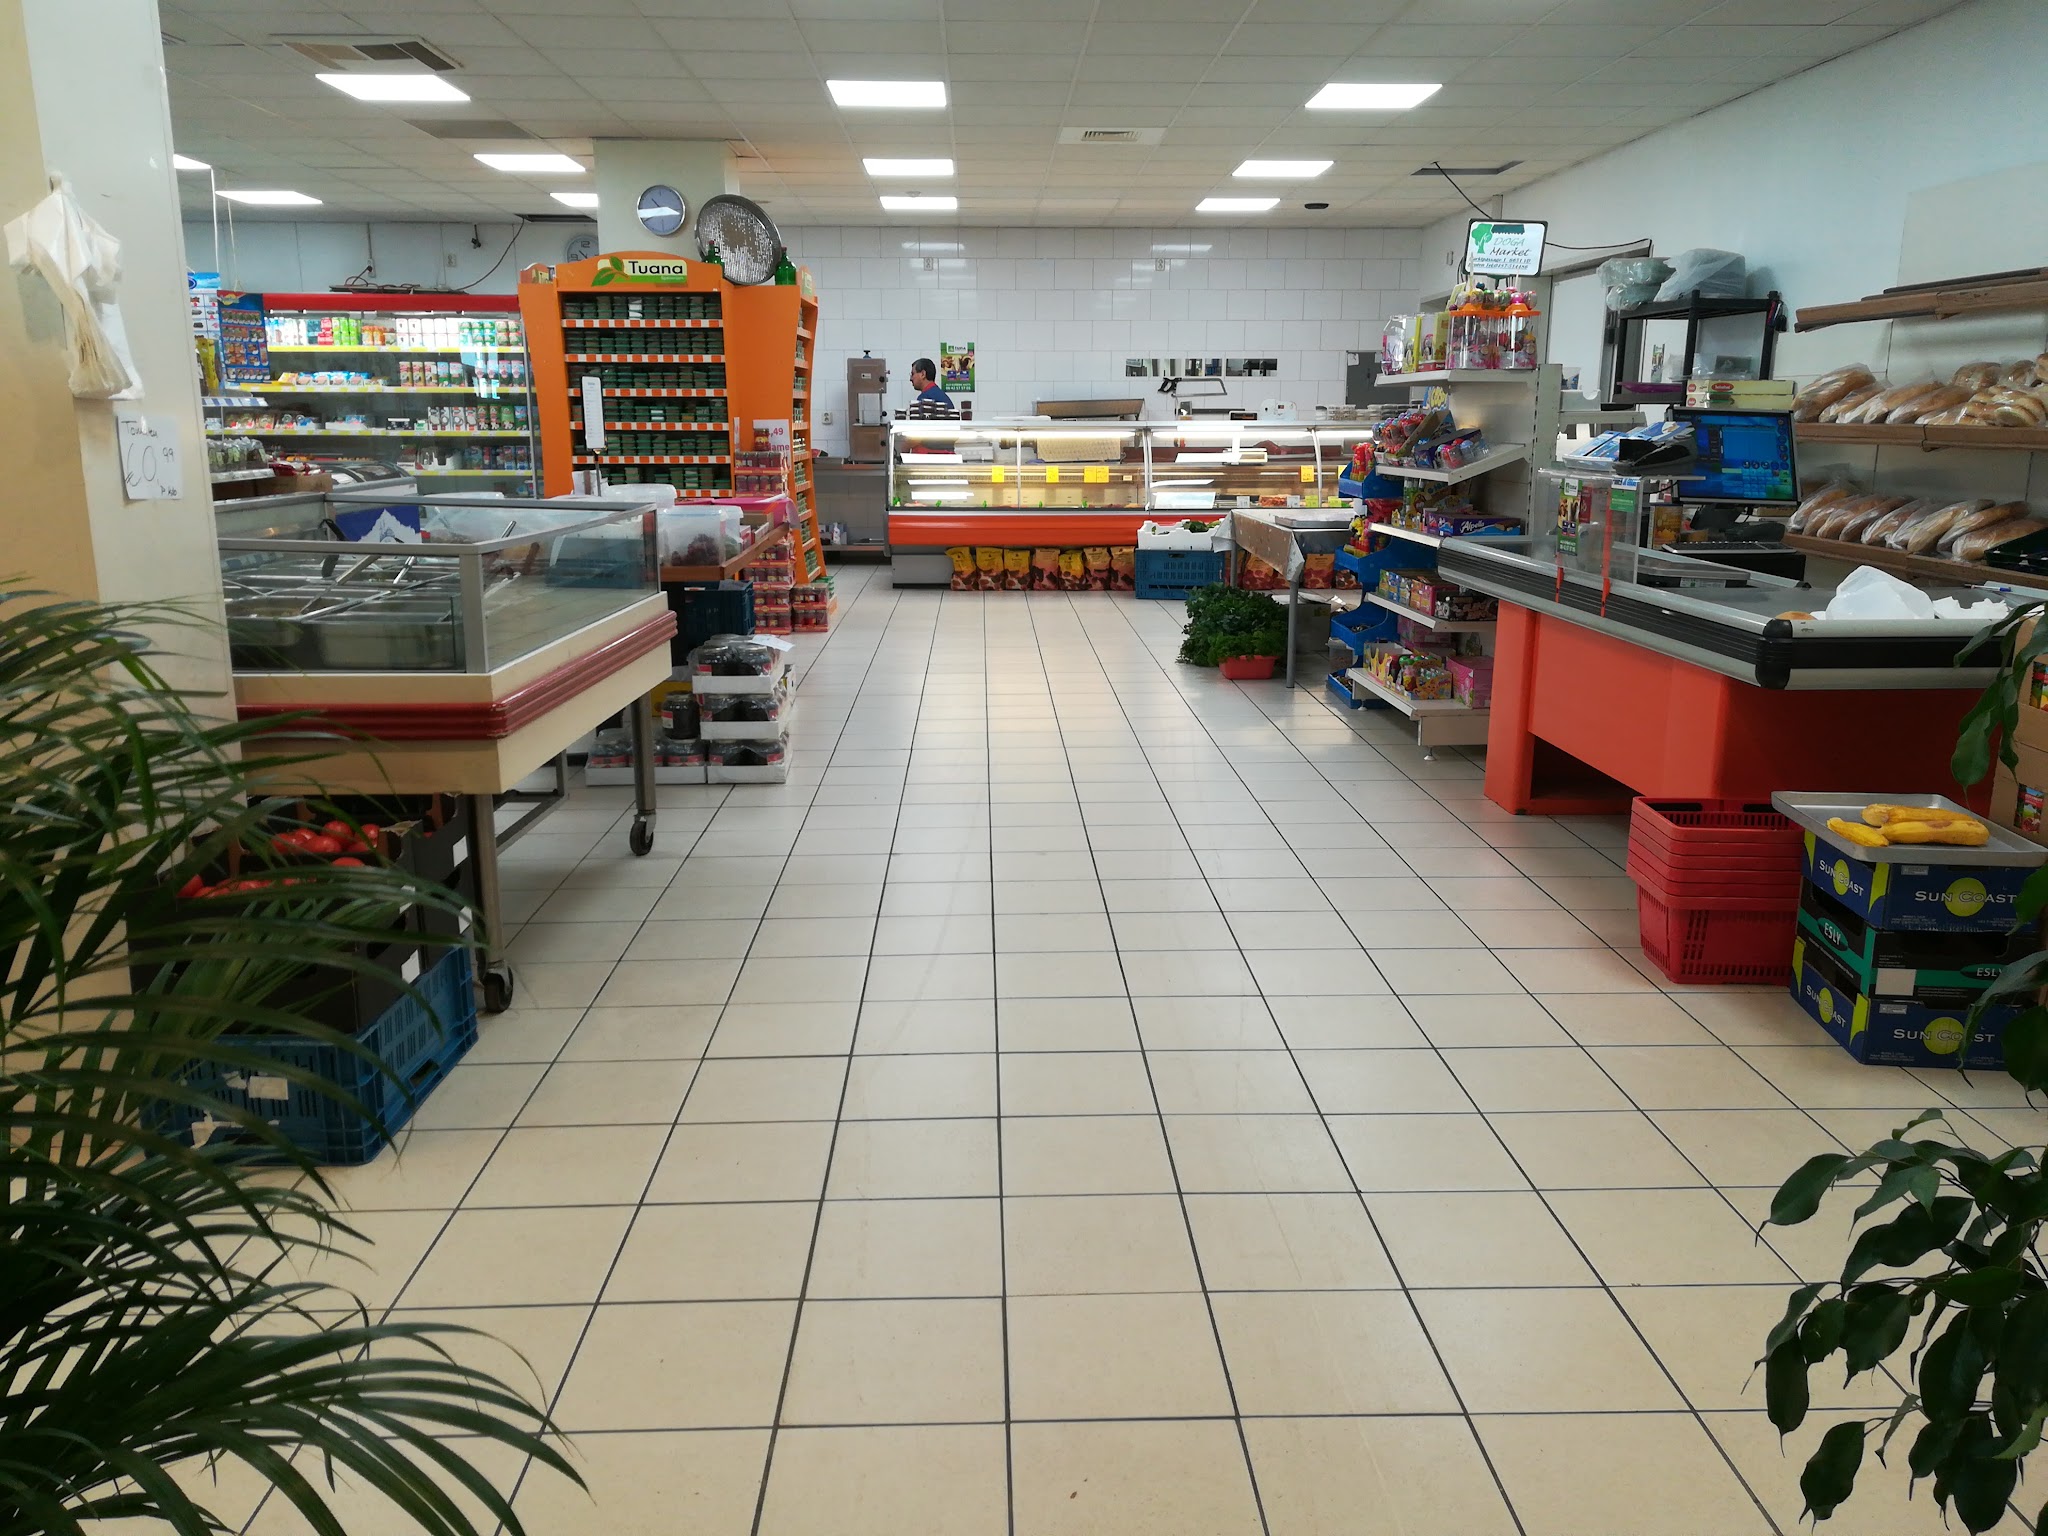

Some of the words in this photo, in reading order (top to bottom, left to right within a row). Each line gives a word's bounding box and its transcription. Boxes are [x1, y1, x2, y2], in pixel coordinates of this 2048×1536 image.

[581, 240, 590, 248] 12
[1493, 237, 1525, 247] DOGA
[1490, 247, 1530, 257] Market
[628, 260, 683, 275] Tuana
[1460, 520, 1485, 534] Alpella
[1824, 922, 1841, 946] ESLY
[1936, 1029, 1996, 1043] COST
